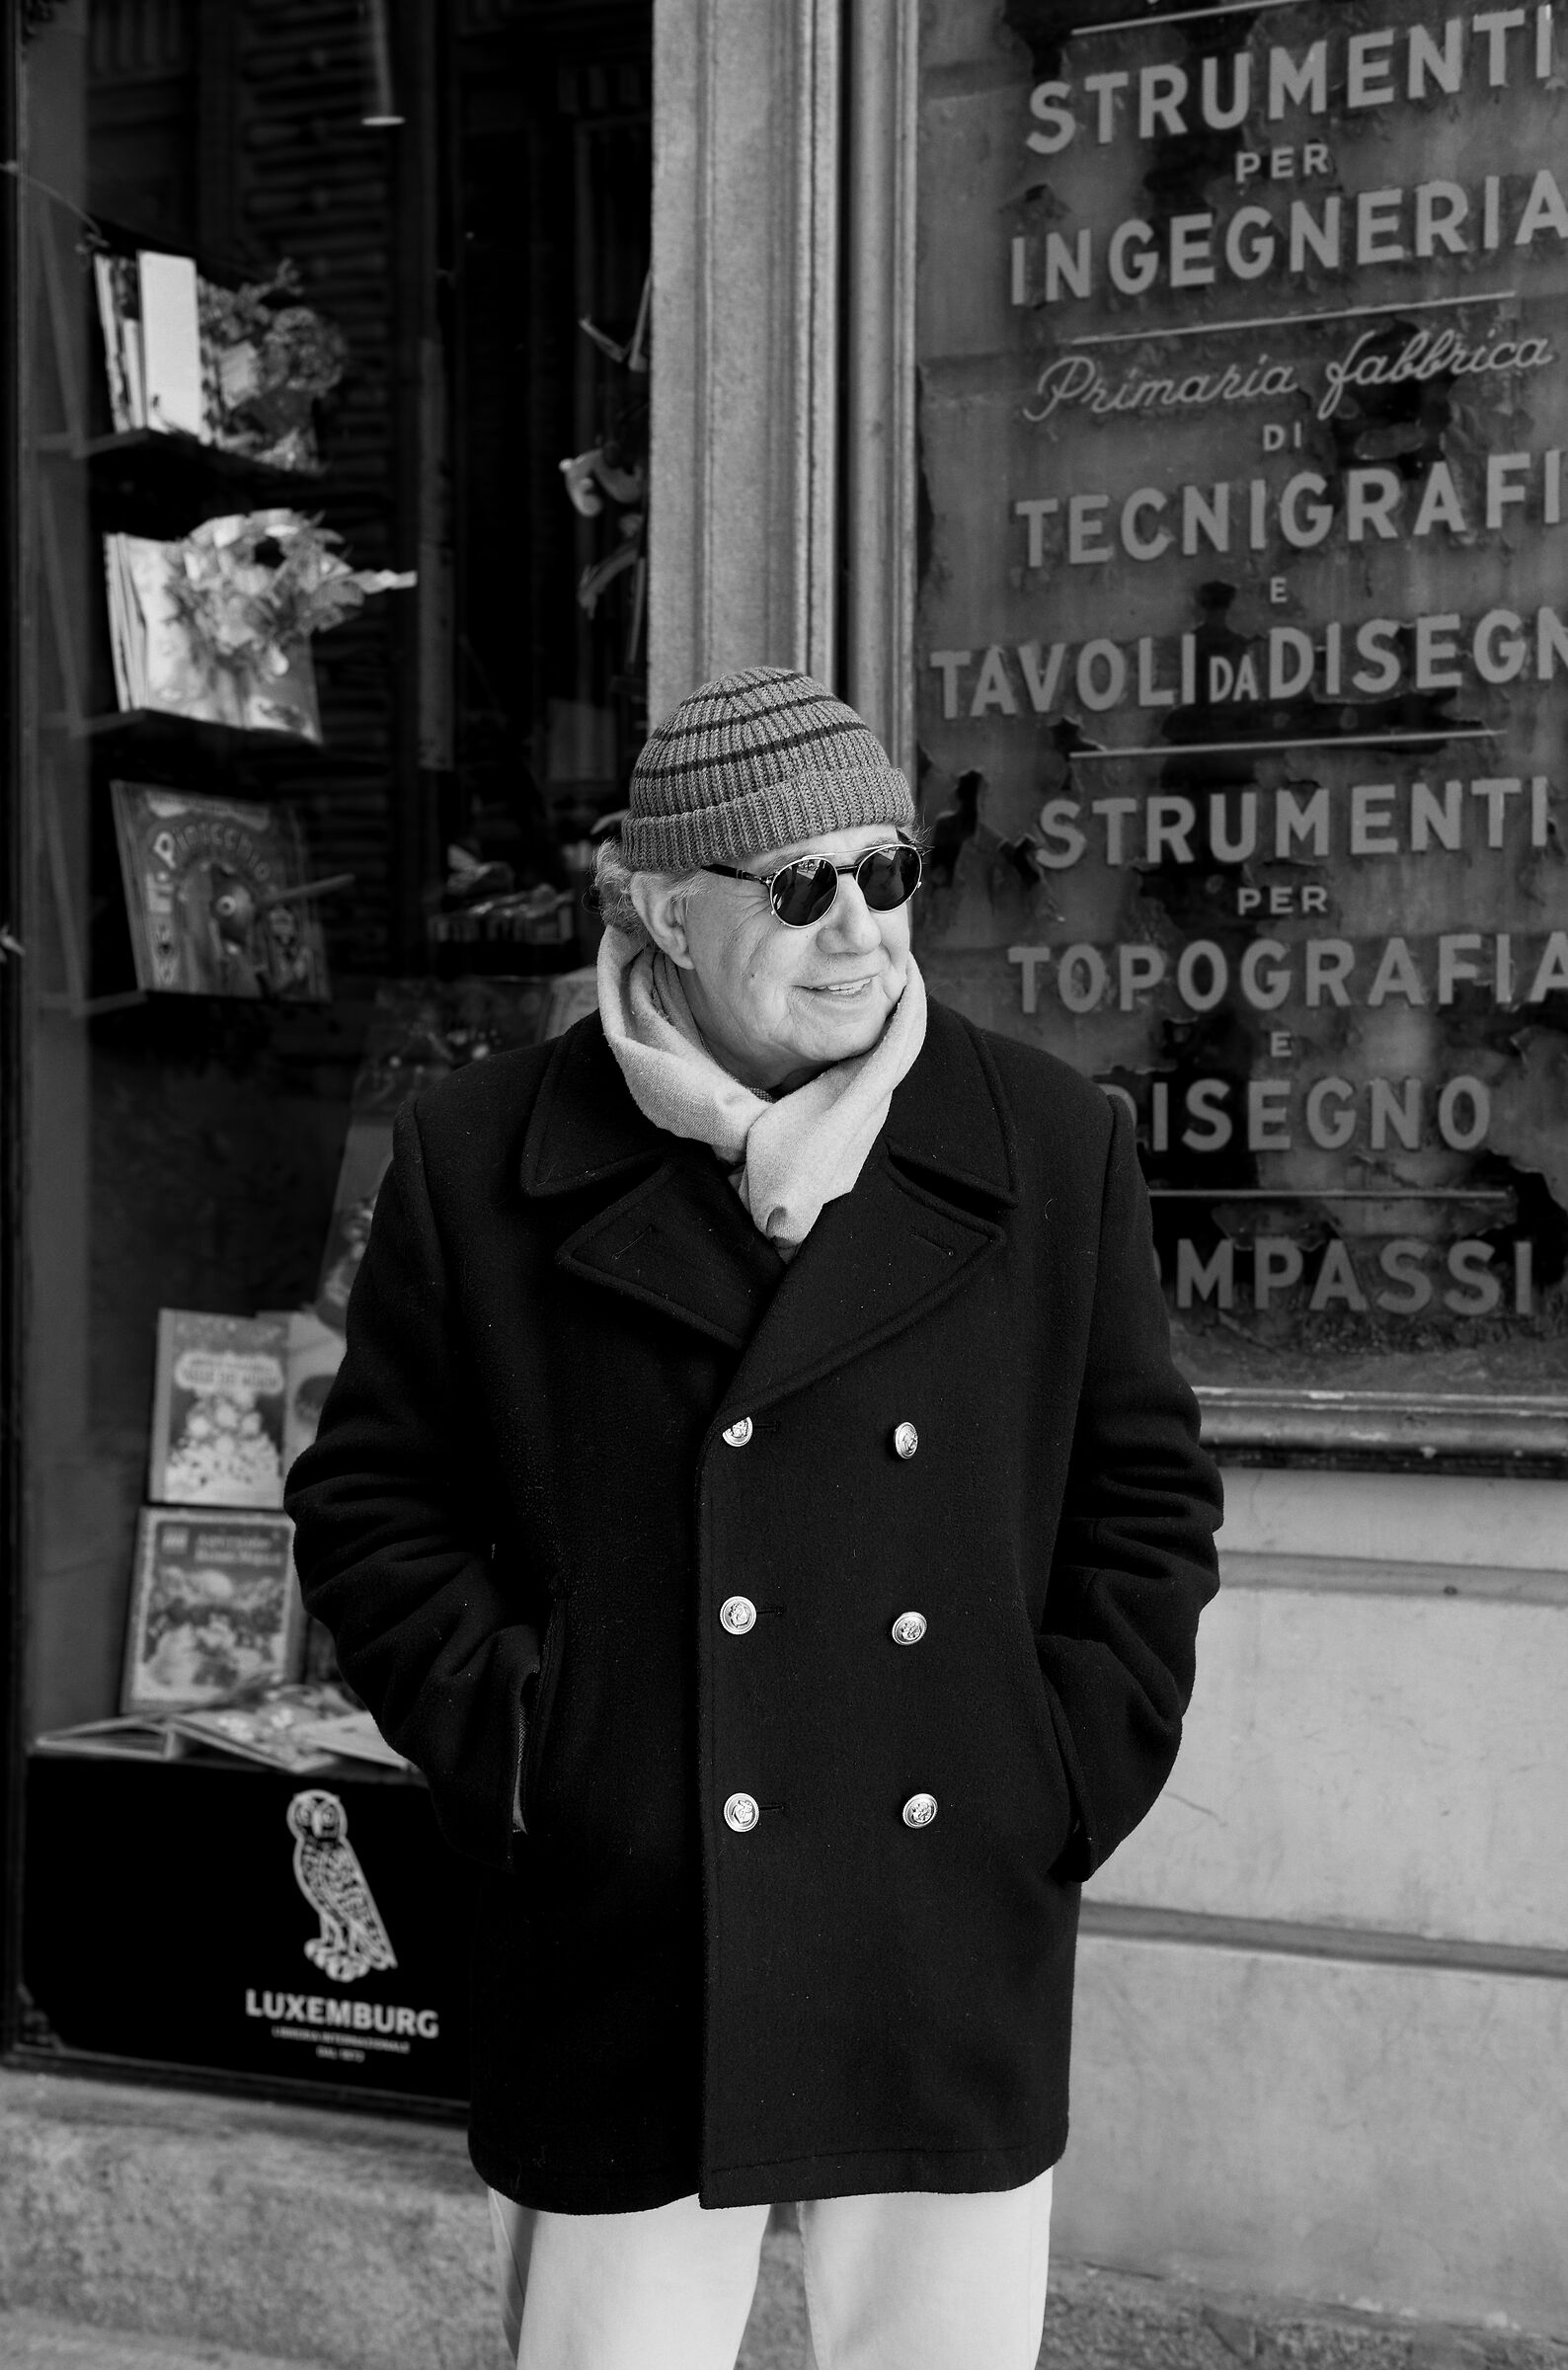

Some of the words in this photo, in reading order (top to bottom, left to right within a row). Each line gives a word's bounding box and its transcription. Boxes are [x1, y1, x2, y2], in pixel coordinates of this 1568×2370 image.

[1025, 3, 1553, 155] STRUMENTI
[1235, 142, 1330, 184] PER
[1010, 169, 1568, 306] INGEGNERIA
[1023, 355, 1298, 422] Primaria
[1317, 328, 1554, 420] fabbrica
[1263, 421, 1302, 451] DI
[1015, 448, 1561, 568] TECNIGRAFI
[1270, 577, 1288, 603] E
[930, 634, 1196, 719] TAVOLI
[1210, 655, 1259, 702] DA
[1035, 776, 1548, 870] STRUMENTI
[1237, 887, 1329, 916] PER
[1007, 931, 1568, 1014] TOPOGRAFIA
[1270, 1031, 1293, 1058] E
[1151, 1237, 1532, 1316] MPASSI
[246, 1988, 439, 2039] LUXEMBURG
